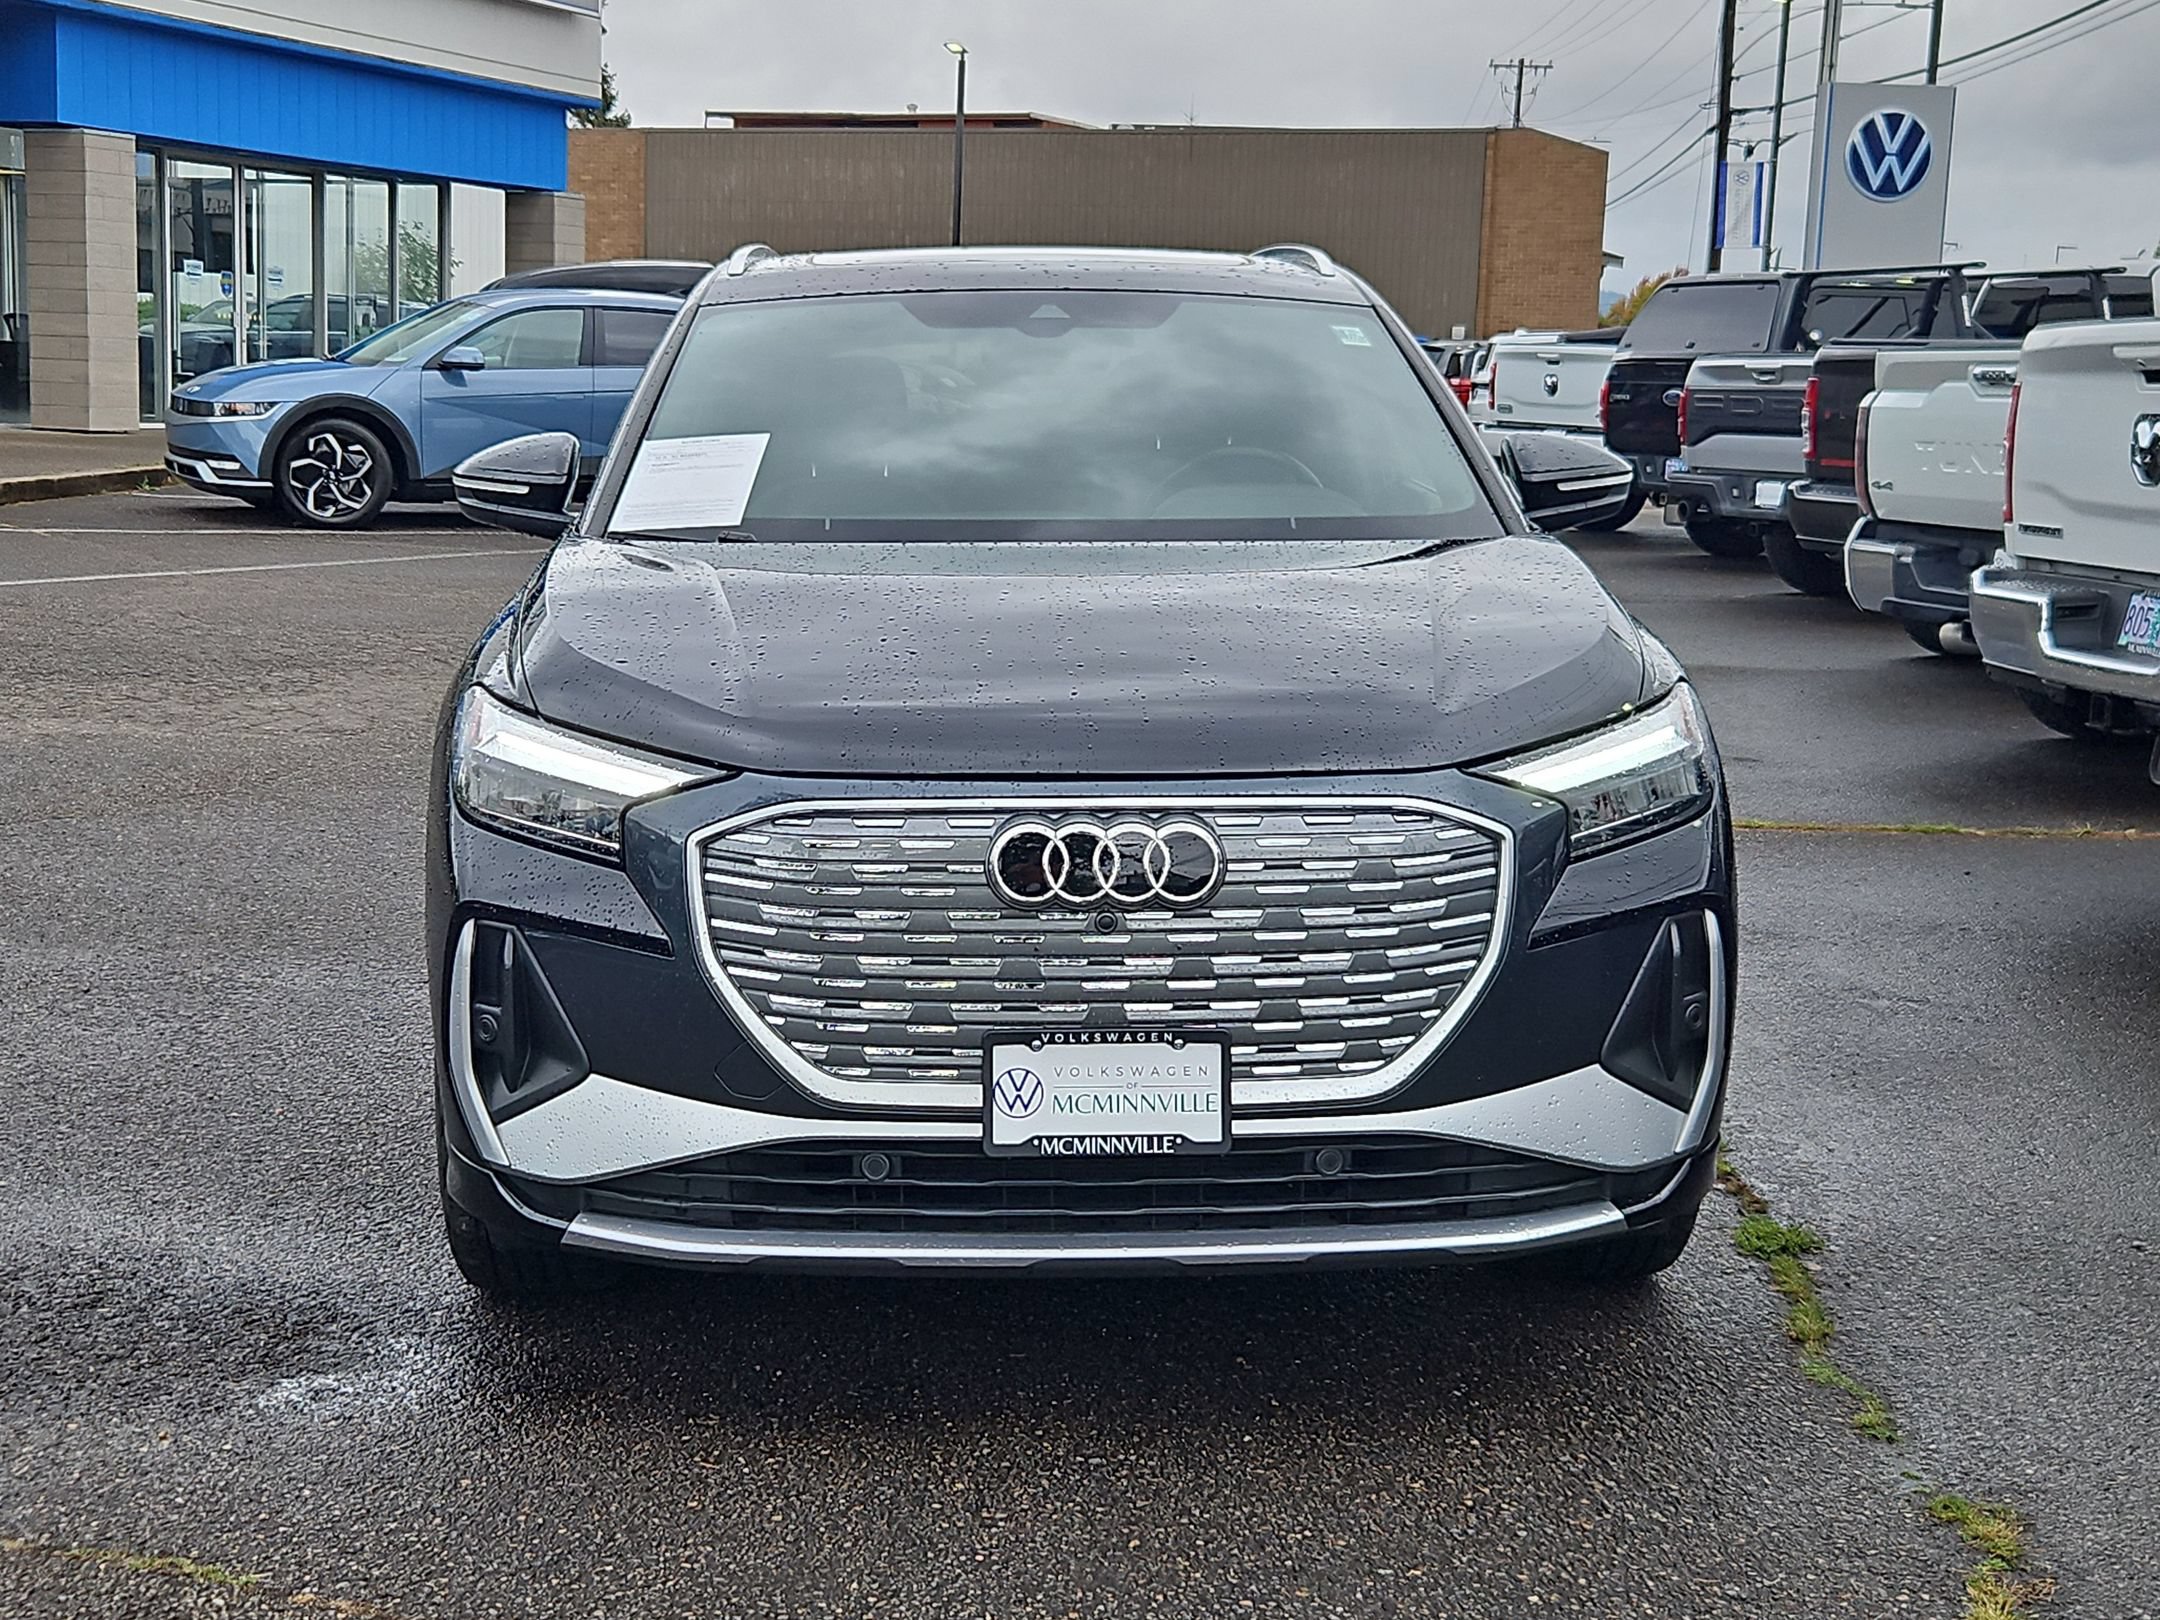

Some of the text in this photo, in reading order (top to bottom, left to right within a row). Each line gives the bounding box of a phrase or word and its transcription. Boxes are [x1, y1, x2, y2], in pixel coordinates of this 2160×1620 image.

[2123, 604, 2155, 638] 805
[1041, 1032, 1173, 1043] VOLKSWAGEN
[1053, 1065, 1209, 1078] VOLKSWAGEN
[1126, 1082, 1139, 1090] OF
[1053, 1092, 1219, 1115] MCMINNVILLE
[1040, 1136, 1175, 1155] MCMINNVILLE
